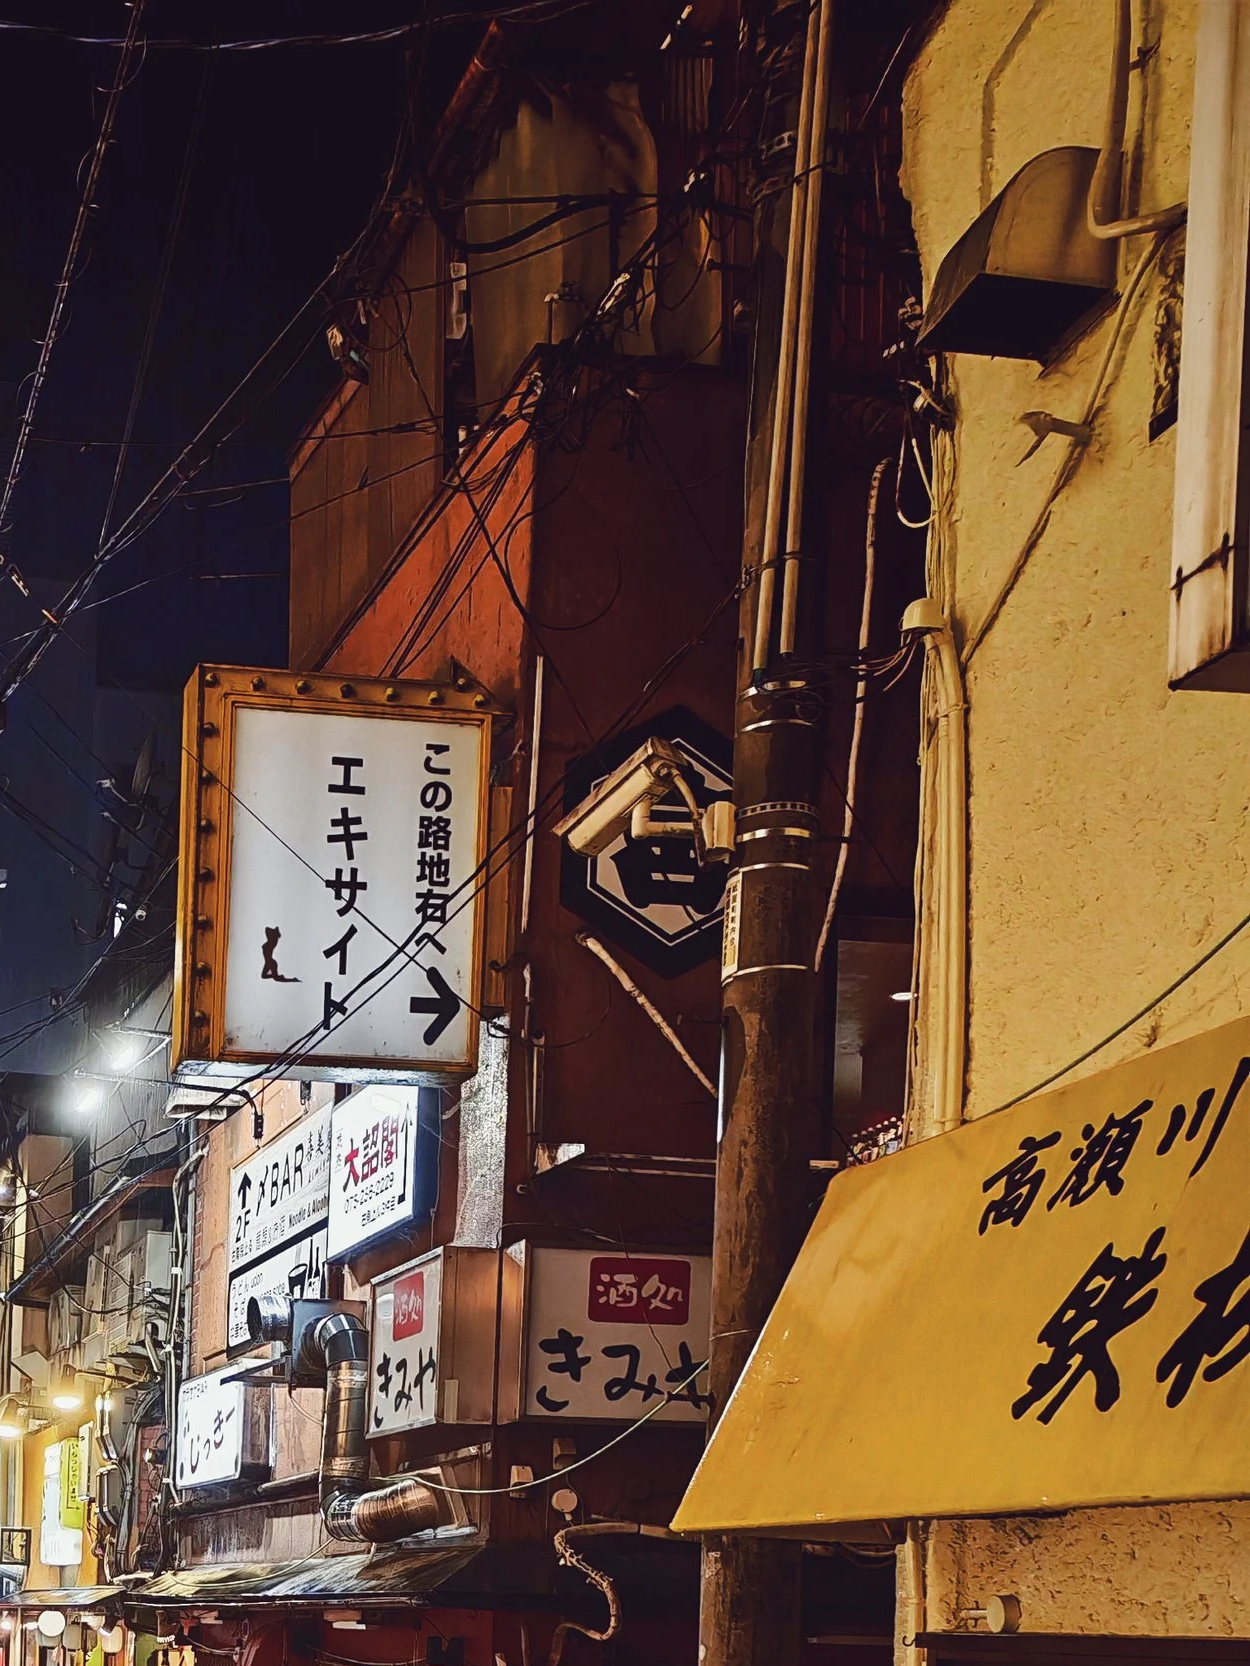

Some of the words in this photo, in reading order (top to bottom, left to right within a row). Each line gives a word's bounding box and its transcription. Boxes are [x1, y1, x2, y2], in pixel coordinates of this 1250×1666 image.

[414, 742, 453, 955] この路地右へ
[323, 755, 368, 1031] エキサイト
[235, 1208, 251, 1243] 2F
[596, 1273, 684, 1311] 酒処
[374, 1346, 436, 1429] きみや
